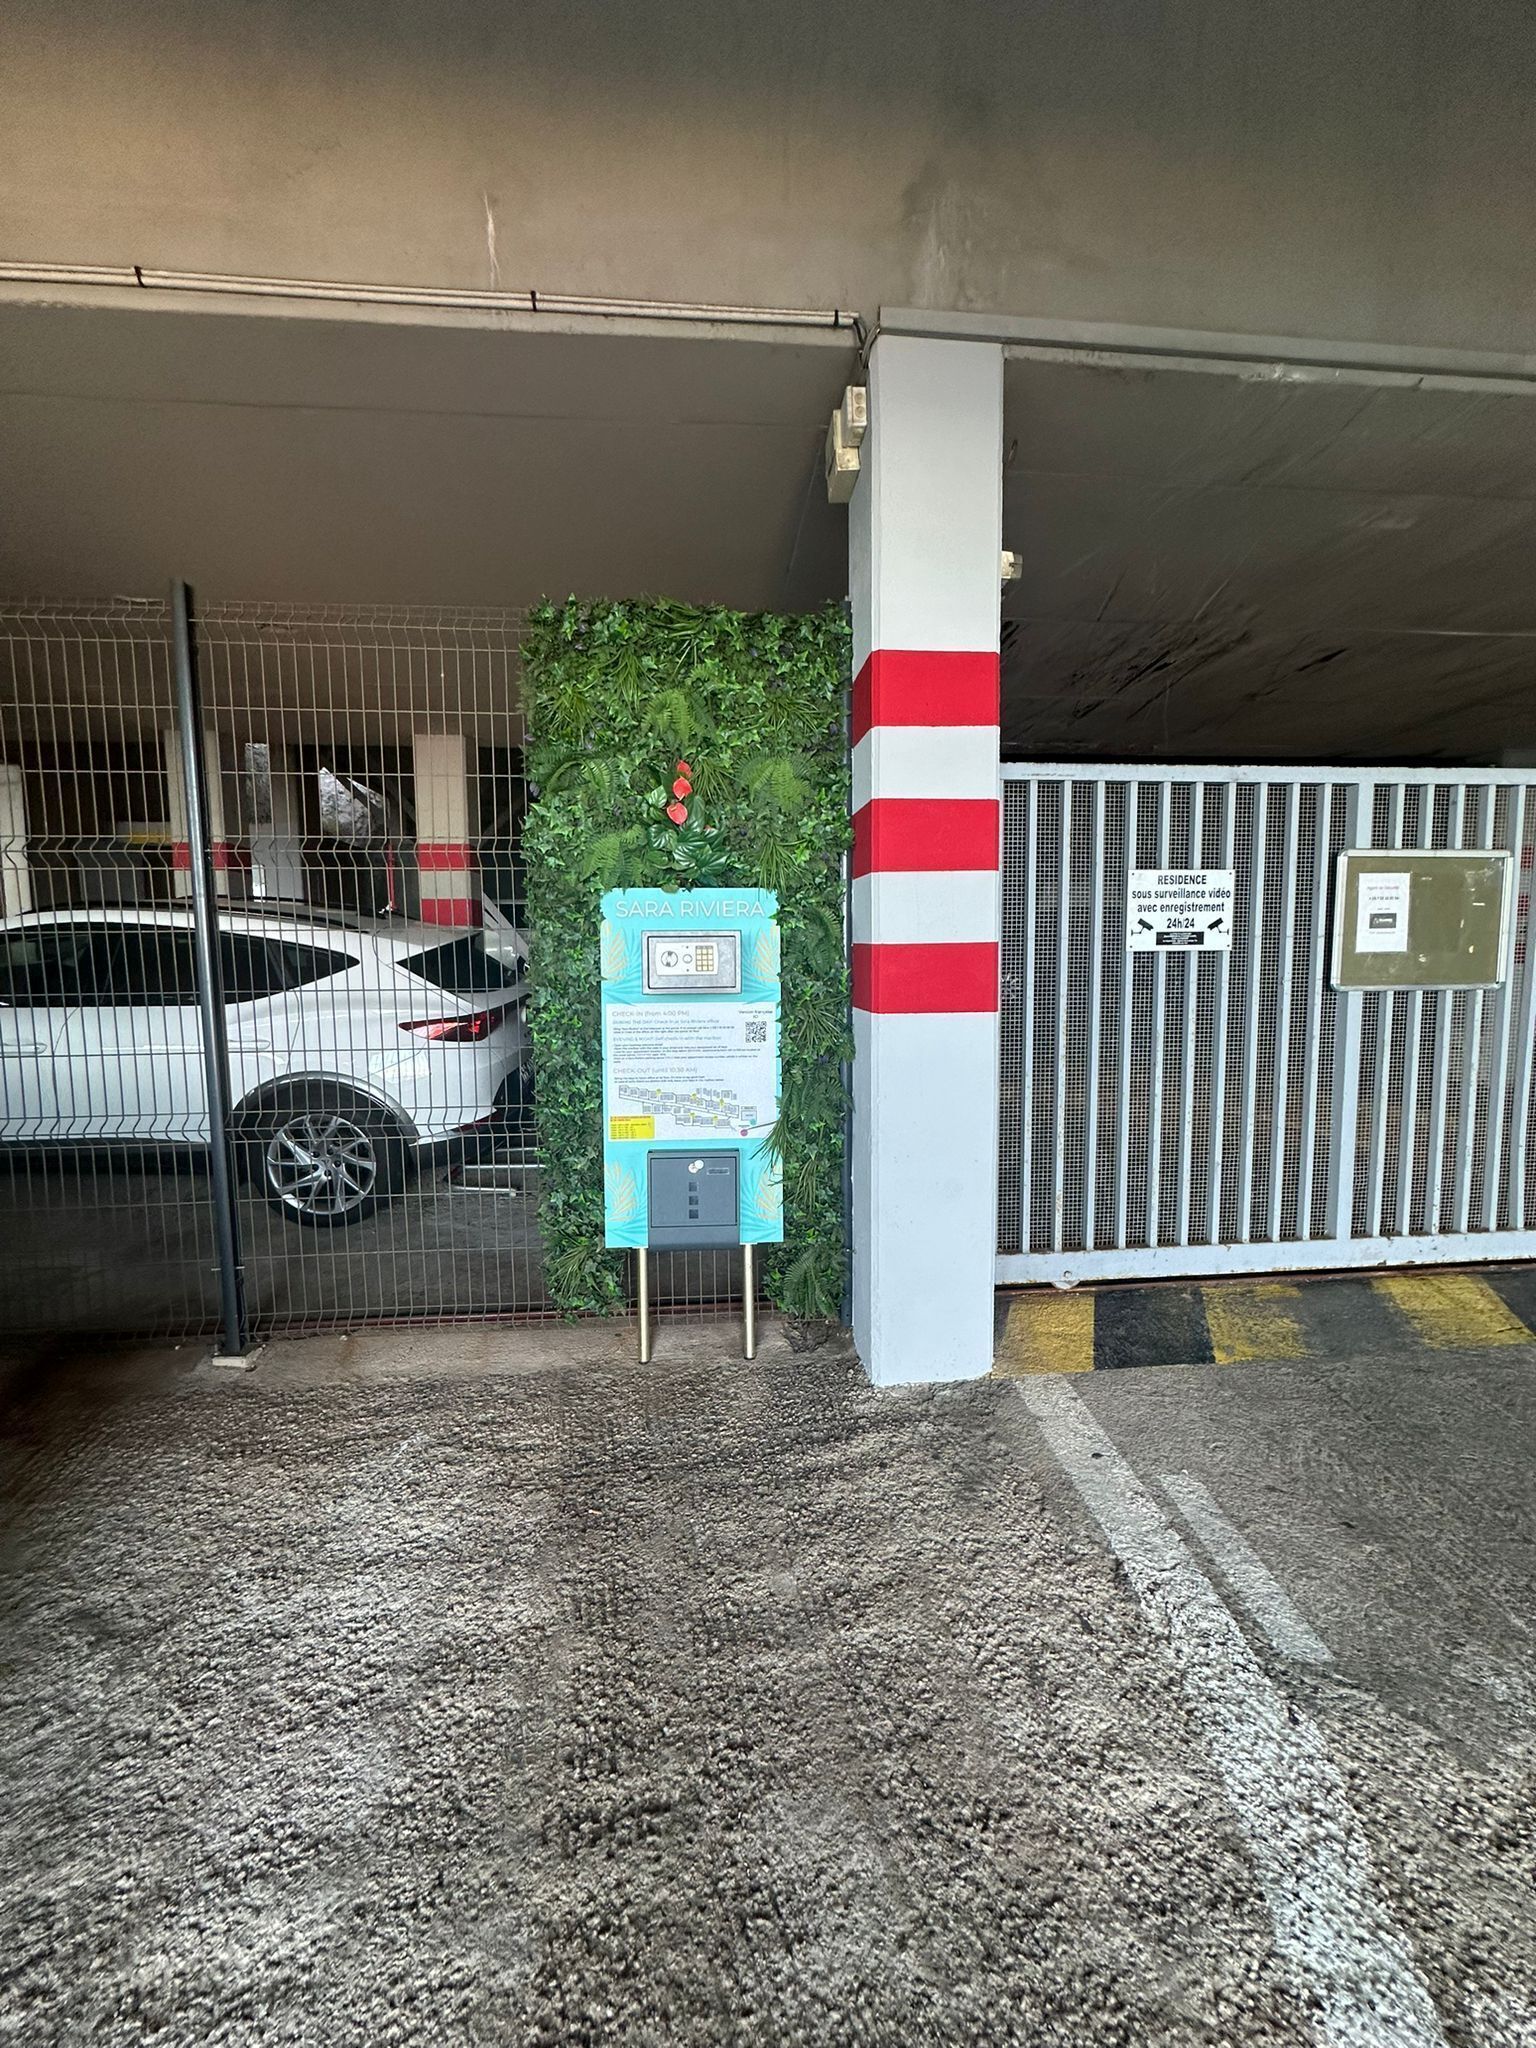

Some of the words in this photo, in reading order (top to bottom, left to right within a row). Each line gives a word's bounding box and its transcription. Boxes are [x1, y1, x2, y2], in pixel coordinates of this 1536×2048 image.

[1157, 874, 1207, 886] RESIDENCE
[1131, 890, 1152, 899] sous
[1154, 888, 1206, 899] surveillance
[1208, 887, 1231, 899] vidéo
[615, 900, 675, 919] SARA
[680, 899, 766, 918] RIVIERA
[1137, 903, 1158, 913] avec
[1159, 901, 1225, 915] enregistrement
[1166, 917, 1195, 929] 24h/24
